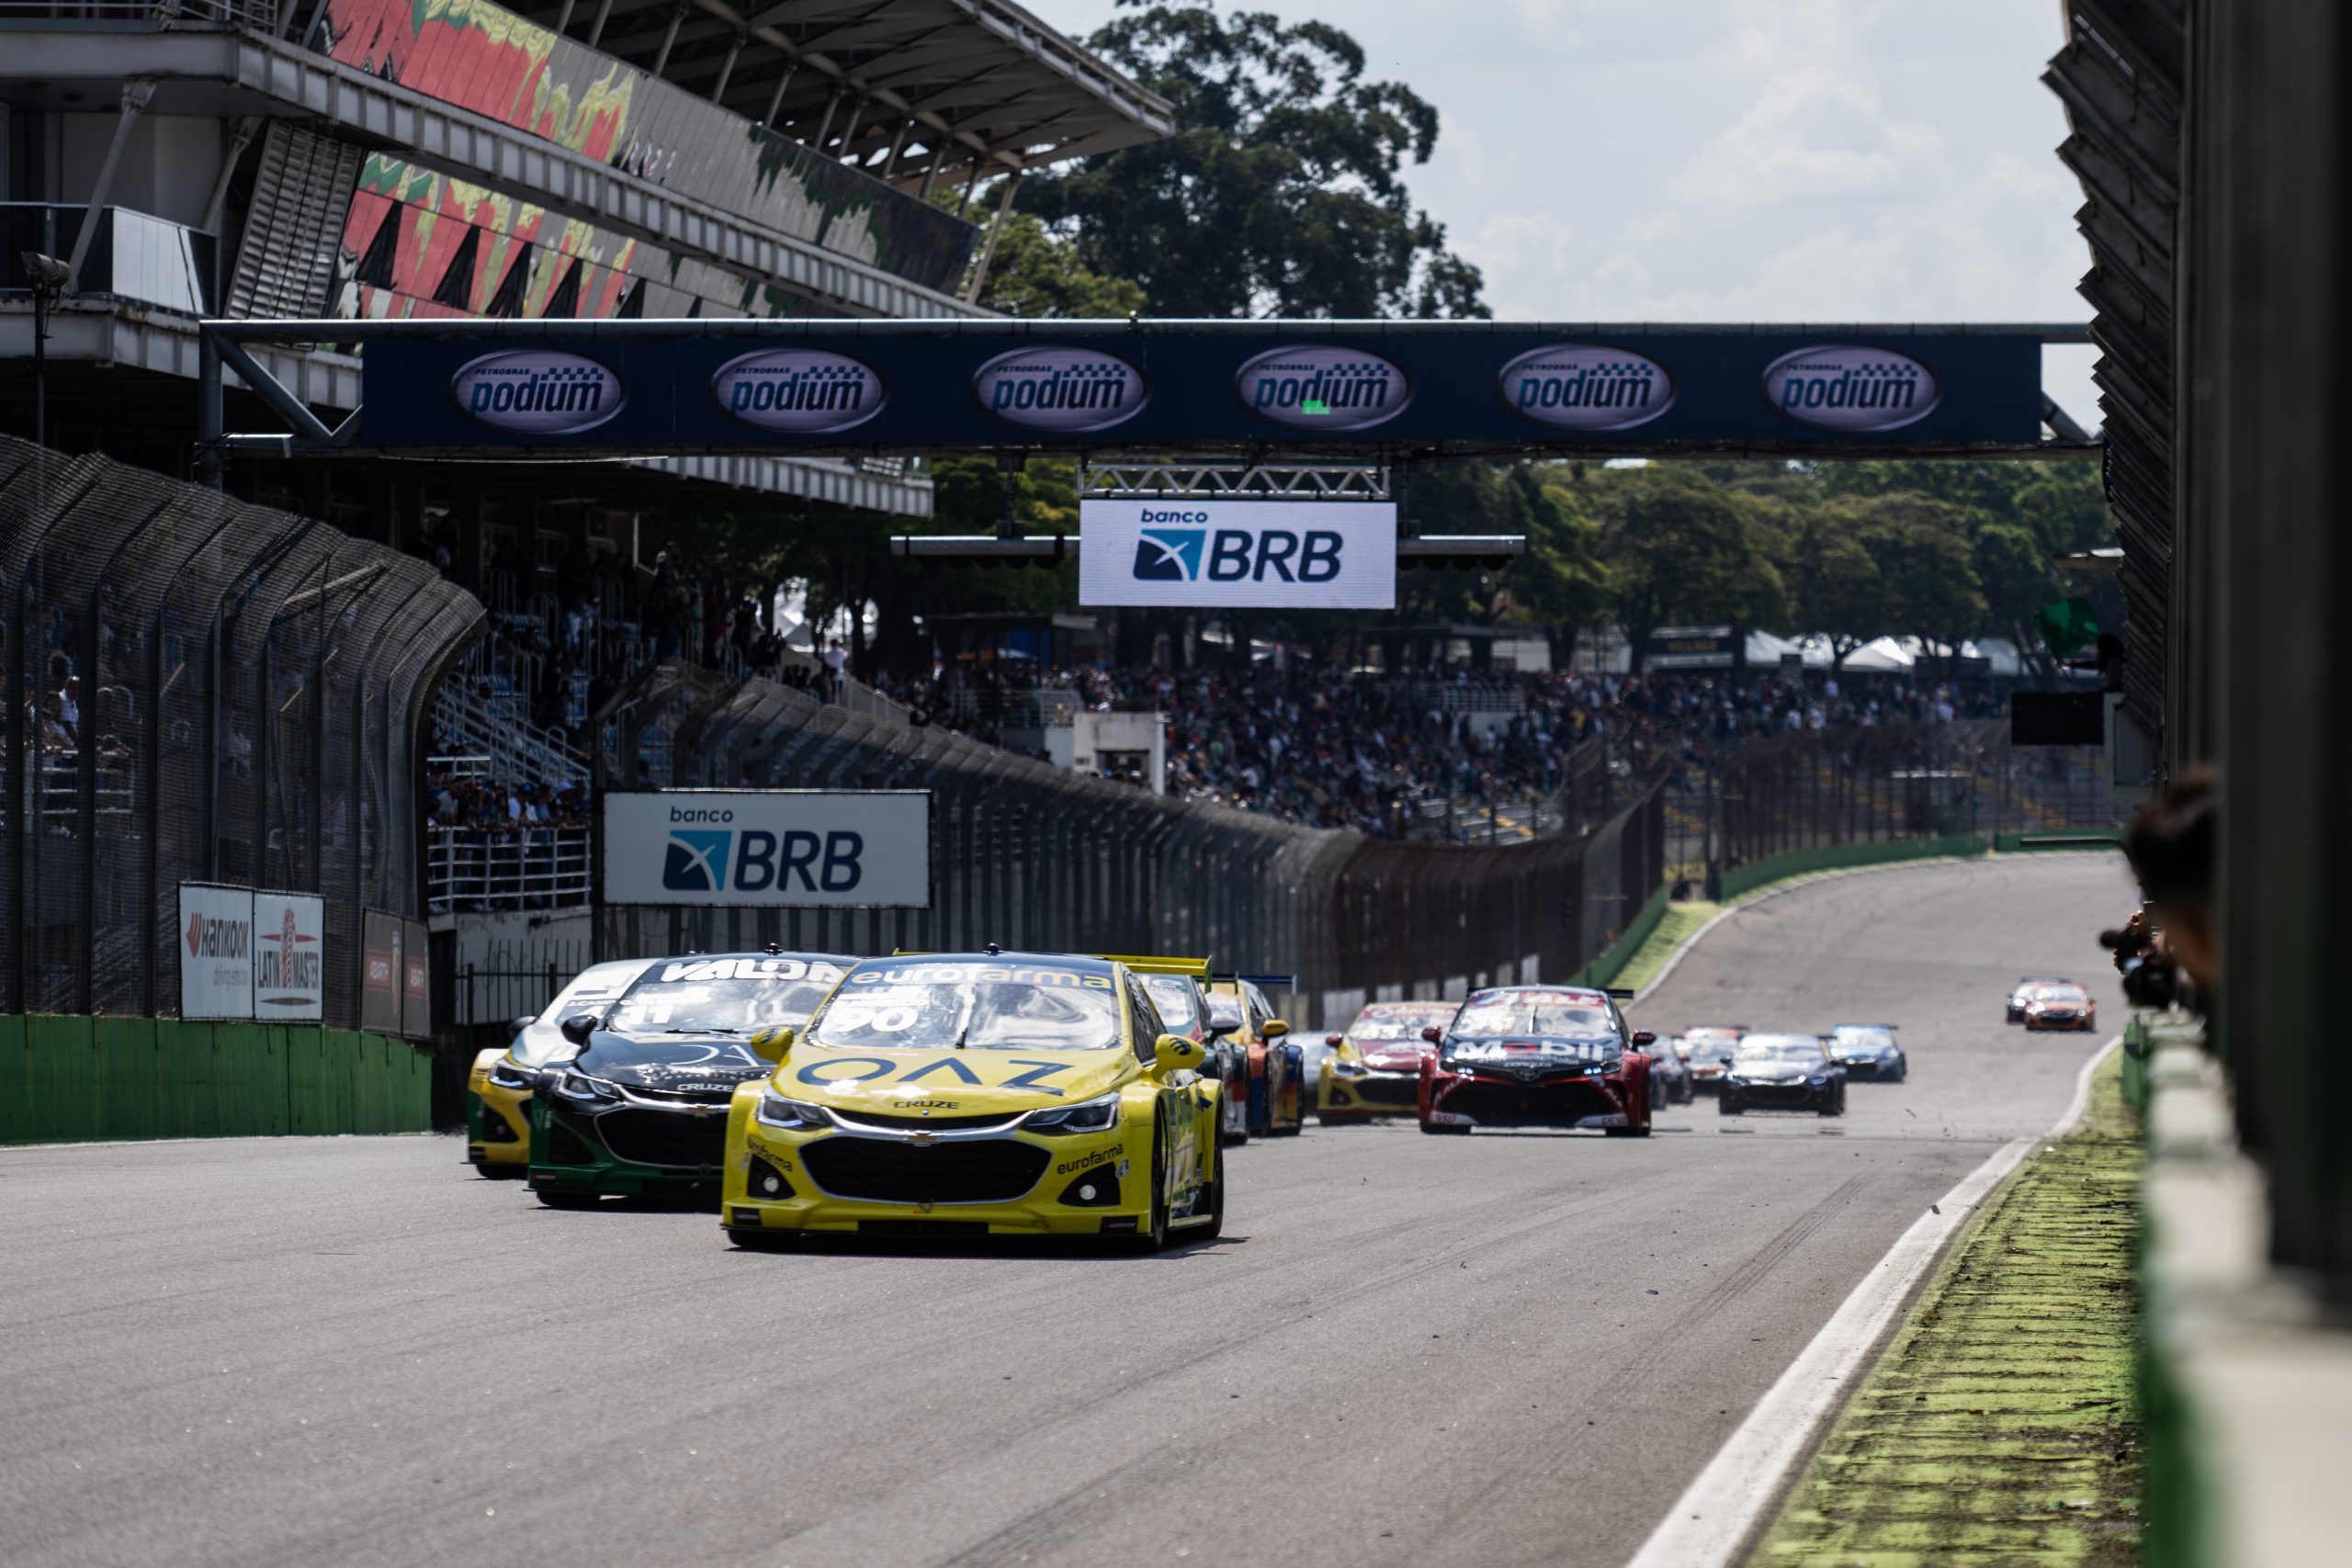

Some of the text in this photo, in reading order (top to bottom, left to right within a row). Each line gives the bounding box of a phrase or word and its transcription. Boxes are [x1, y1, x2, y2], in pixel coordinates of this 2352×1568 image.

[475, 367, 530, 376] PETROBRAS
[735, 367, 790, 375] PETROBRAS
[996, 365, 1052, 373] PETROBRAS
[469, 374, 603, 414] podium
[731, 374, 863, 413] podium
[992, 371, 1125, 411] podium
[1255, 371, 1386, 411] podium
[1518, 370, 1652, 410] podium
[1782, 371, 1916, 410] podium
[1140, 508, 1208, 524] banco
[1207, 529, 1343, 582] BRB
[670, 806, 734, 823] banco
[733, 830, 865, 892] BRB
[257, 950, 319, 990] LATIN MASTER
[851, 966, 1112, 989] eurofarma
[619, 1002, 674, 1025] 11
[831, 1006, 919, 1032] 90
[1453, 1040, 1604, 1062] Mobil
[676, 1082, 735, 1093] CRUZE
[893, 1100, 960, 1110] CRUZE
[1057, 1142, 1125, 1176] eurofarma
